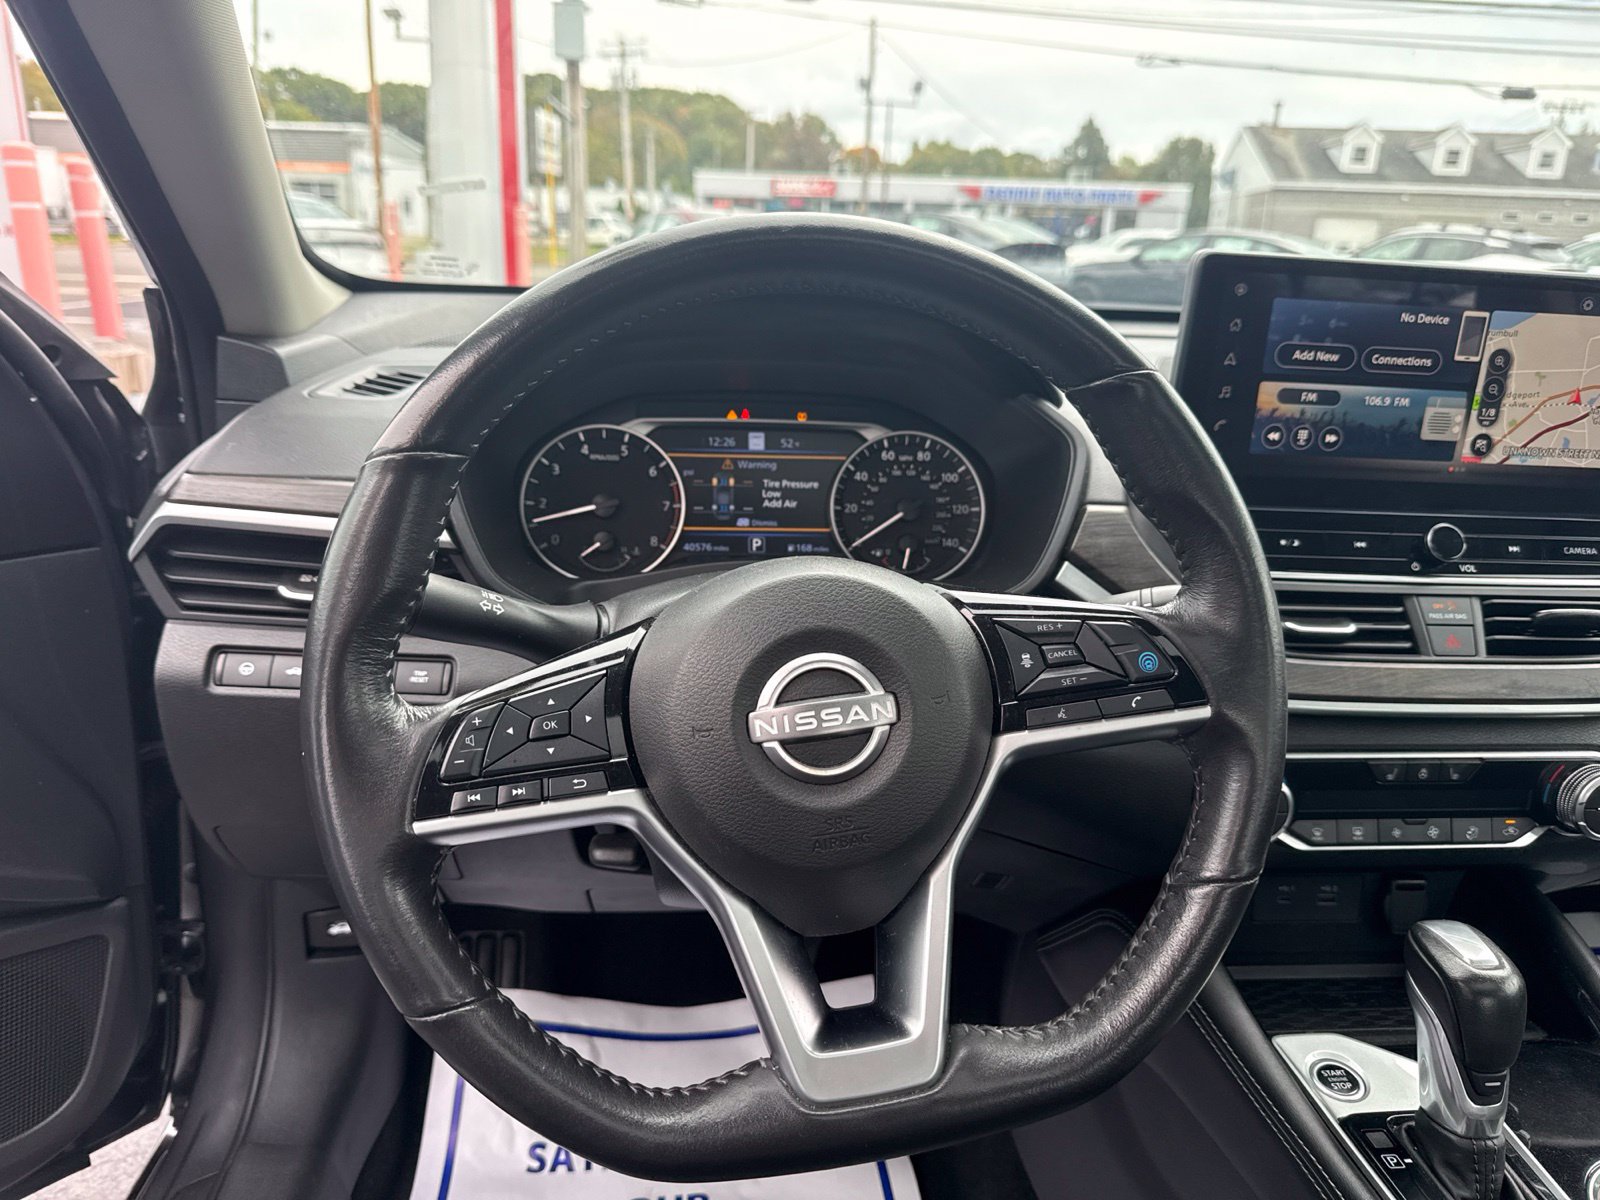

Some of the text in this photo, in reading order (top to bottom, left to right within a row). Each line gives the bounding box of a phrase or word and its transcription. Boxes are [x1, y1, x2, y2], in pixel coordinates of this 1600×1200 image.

[1400, 312, 1450, 325] No Device
[1292, 350, 1341, 362] Add New
[1371, 354, 1432, 367] Connections
[1301, 391, 1318, 402] FM
[1504, 391, 1540, 401] dgeport
[1364, 396, 1410, 407] 106.9 FM
[1481, 407, 1496, 416] 1/8
[708, 436, 736, 447] 12:26
[580, 445, 589, 455] 4
[620, 445, 629, 456] 5
[1502, 446, 1557, 458] UNKNOWN
[1558, 448, 1592, 459] STREET
[881, 451, 895, 461] 60
[916, 451, 931, 462] 80
[552, 464, 560, 475] 3
[737, 460, 777, 471] Warning
[649, 467, 657, 477] 6
[853, 471, 868, 481] 40
[941, 473, 959, 483] 100
[763, 479, 819, 489] Tire Pressure
[762, 489, 781, 498] Low
[539, 497, 547, 509] 2
[662, 501, 670, 511] 7
[763, 499, 798, 508] Add Air
[844, 503, 858, 513] 20
[952, 504, 969, 514] 120
[683, 543, 712, 551] 40576
[752, 538, 761, 551] P
[941, 538, 959, 547] 140
[1563, 546, 1598, 555] CAMERA
[1458, 564, 1478, 573] VOL
[1037, 624, 1054, 632] RES
[1048, 650, 1077, 658] CANCEL
[1061, 677, 1076, 686] SET
[754, 702, 893, 737] NISSAN
[542, 721, 558, 730] OK
[812, 834, 870, 852] AIRBAG
[1331, 1082, 1352, 1090] STOP
